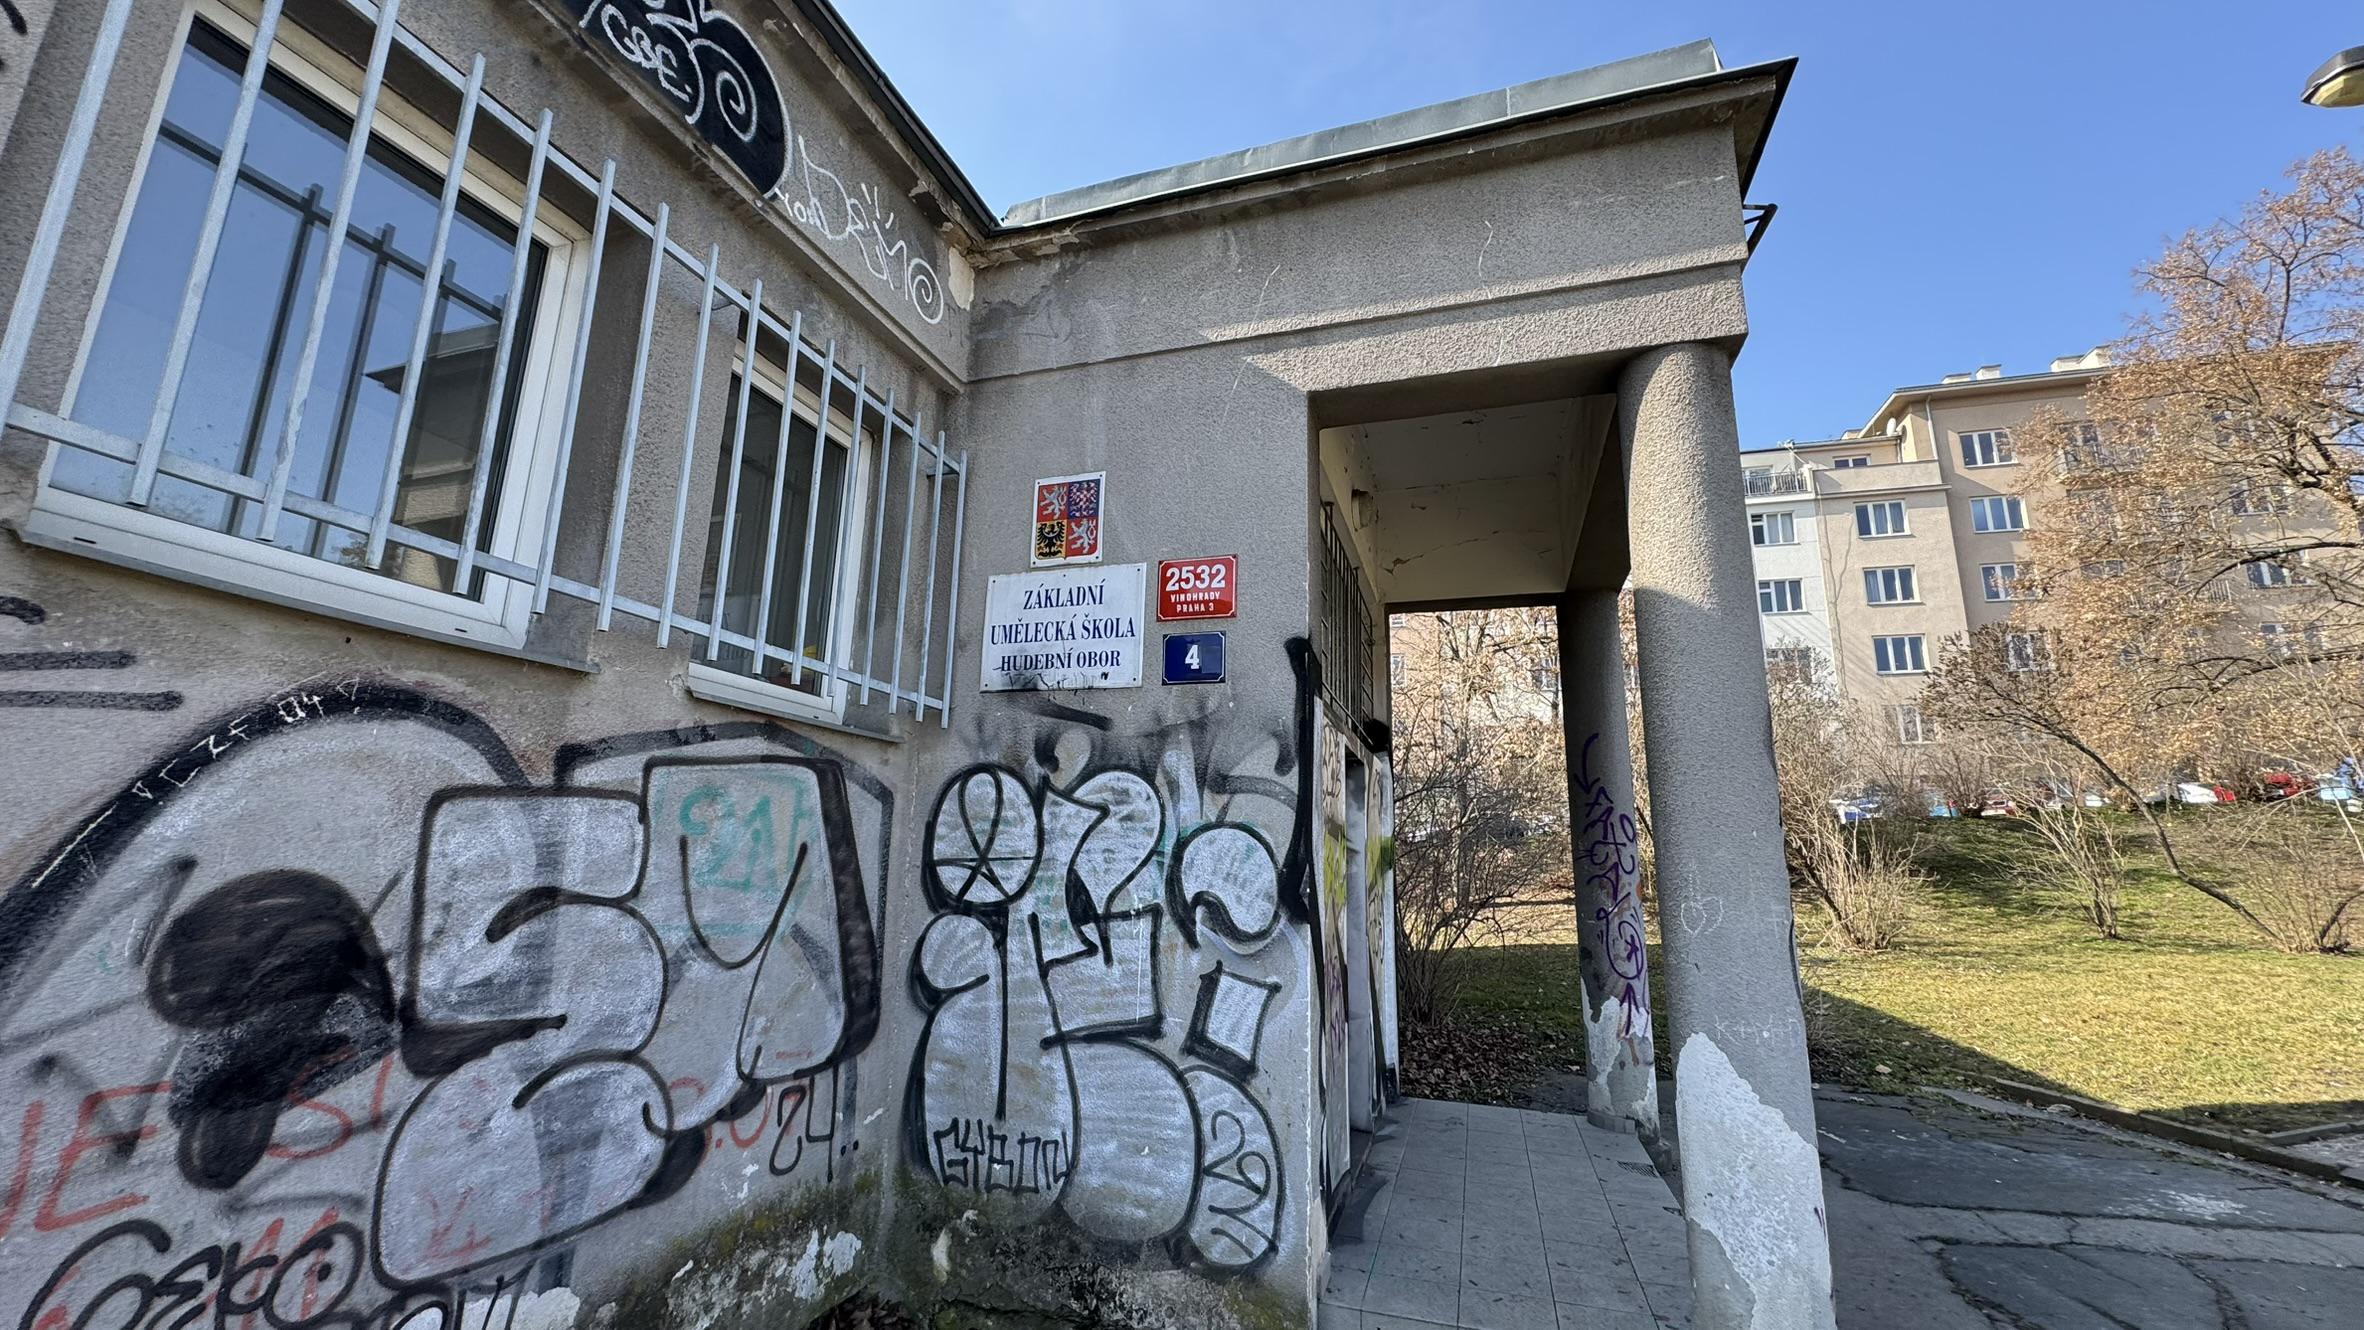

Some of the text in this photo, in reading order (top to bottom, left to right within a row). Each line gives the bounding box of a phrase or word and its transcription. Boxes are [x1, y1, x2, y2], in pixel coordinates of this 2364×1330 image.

[1166, 564, 1226, 591] 2532
[1023, 578, 1106, 610] ZÁKLADNÍ
[1170, 591, 1220, 603] VINOHRADY
[1176, 602, 1214, 613] PRAHA 3
[991, 612, 1136, 645] UMĚLECKÁ ŠKOLA
[1000, 647, 1121, 672] HUDEBNÍ OBOR
[1184, 644, 1200, 670] 4
